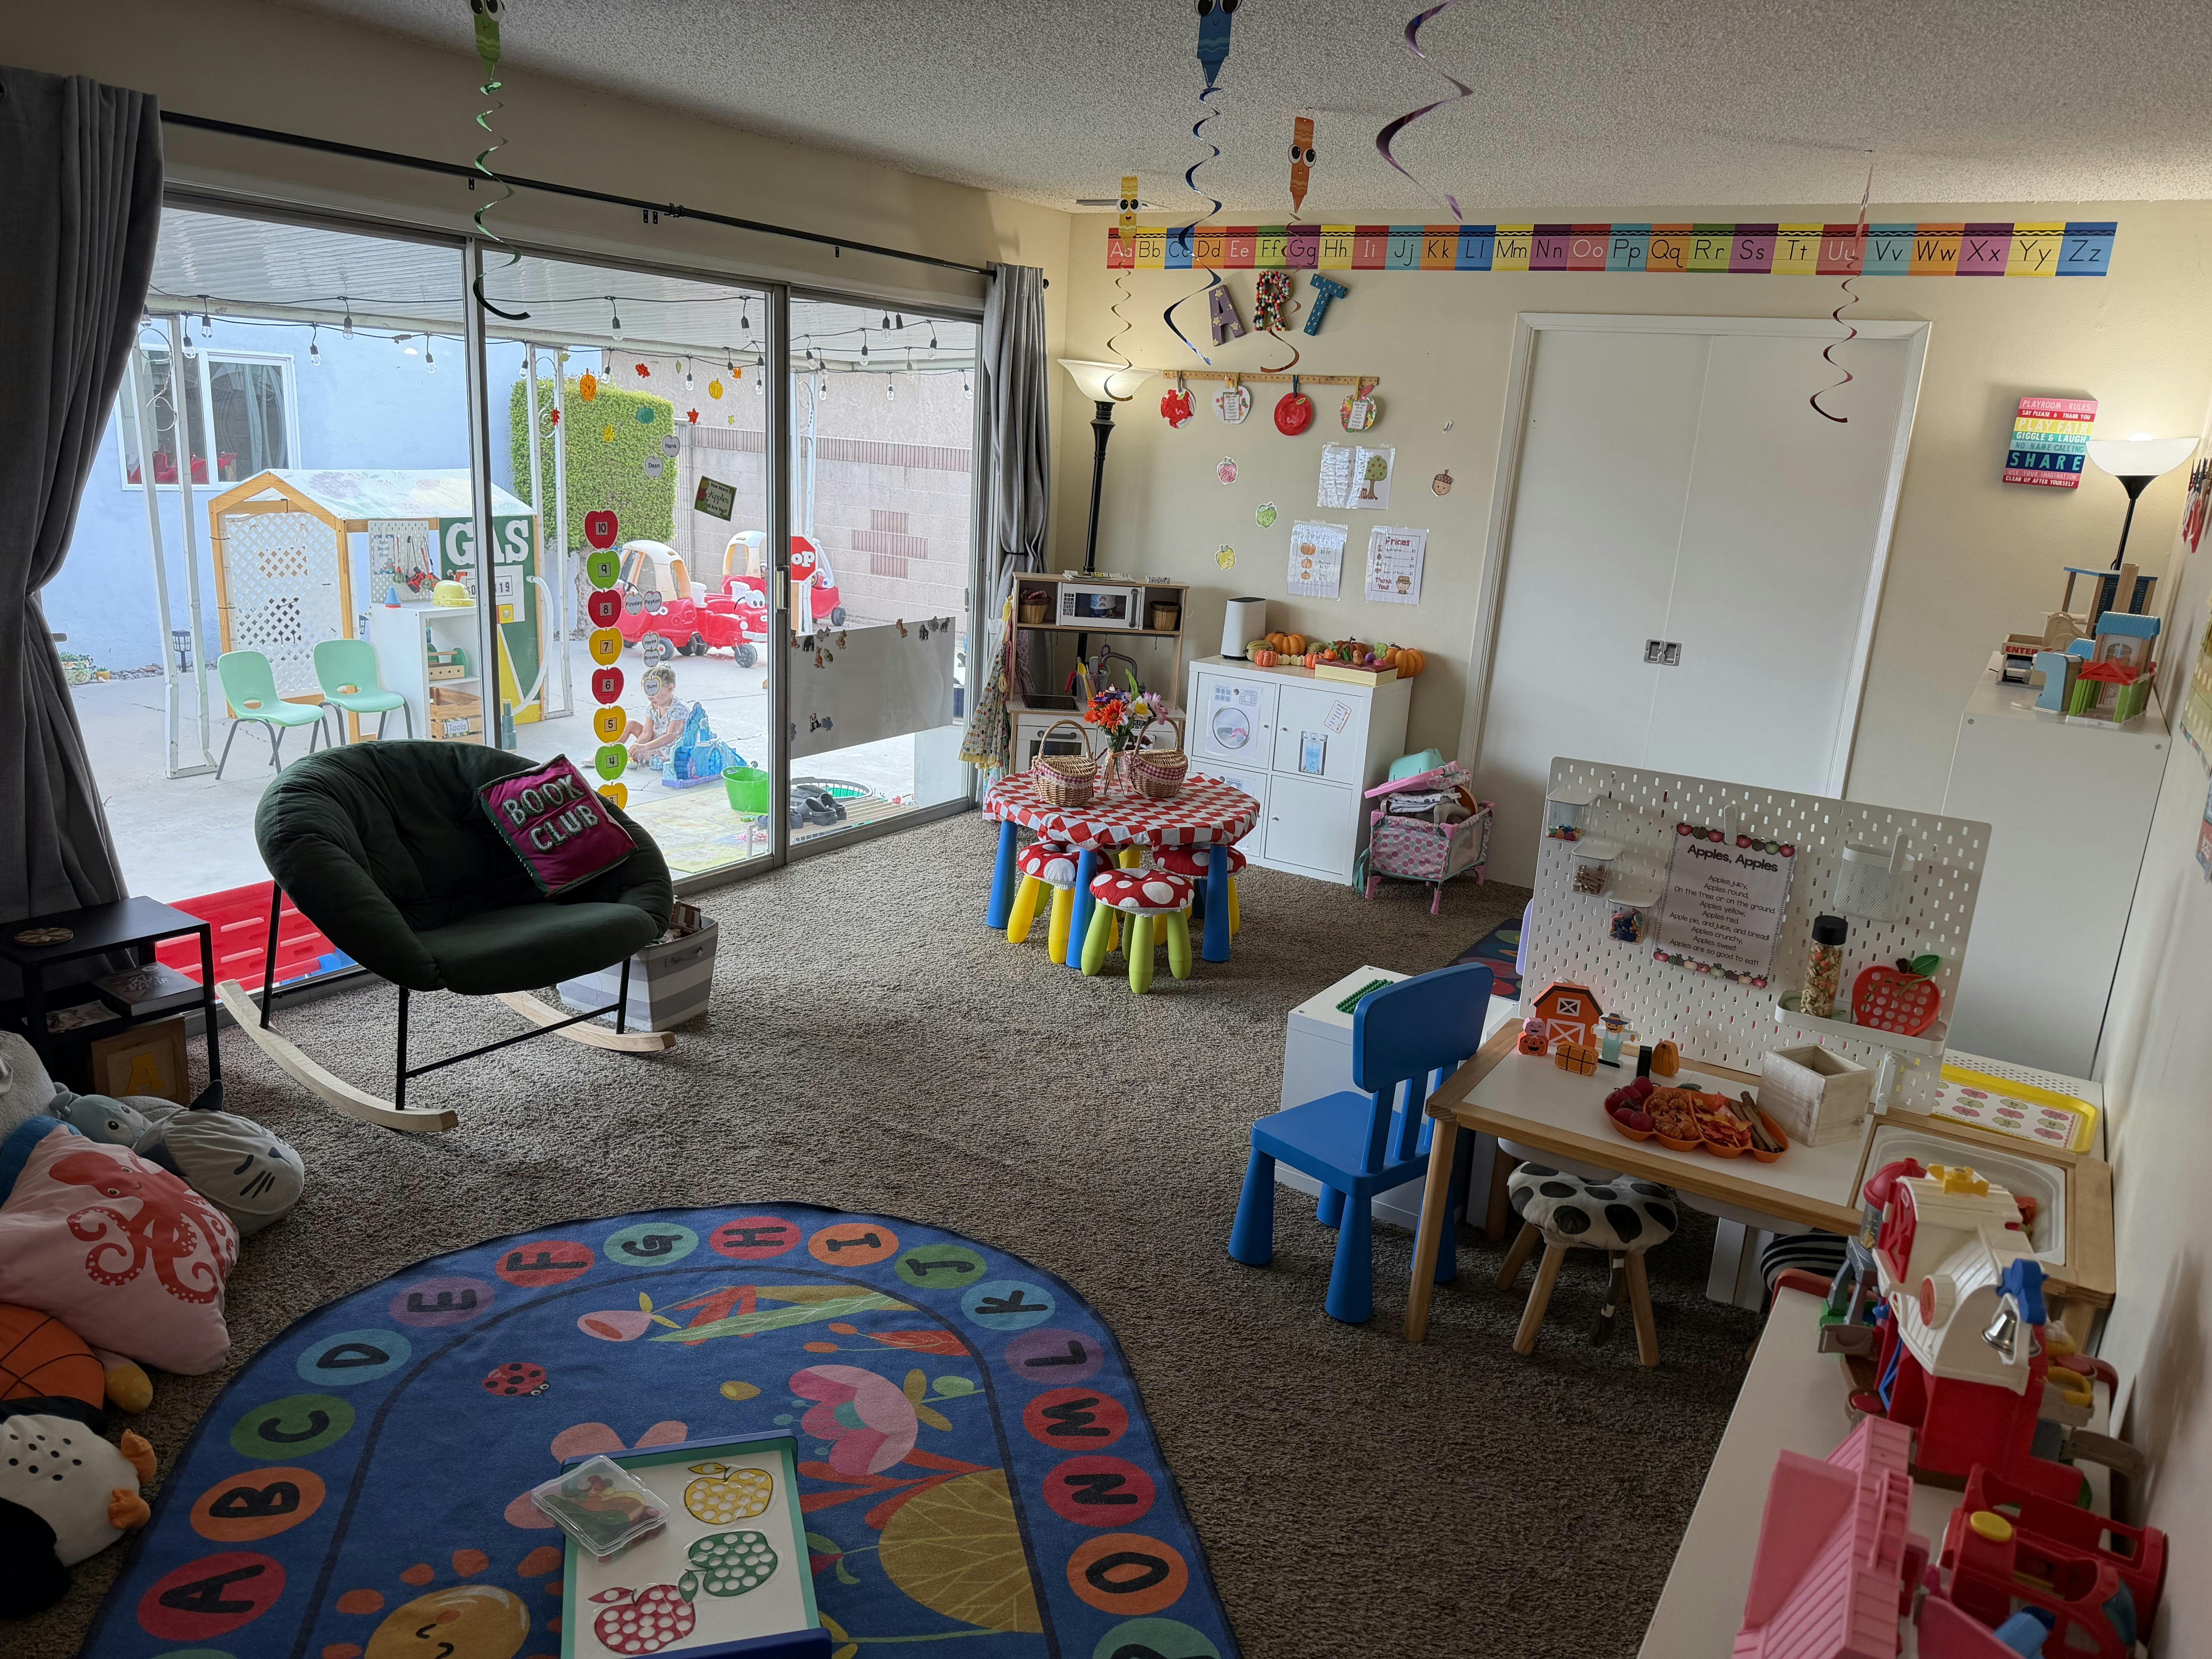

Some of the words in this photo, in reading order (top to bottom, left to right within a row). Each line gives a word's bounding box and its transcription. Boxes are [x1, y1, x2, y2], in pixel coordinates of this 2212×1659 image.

[1139, 241, 1160, 257] Bb
[1198, 240, 1220, 257] Dd
[1231, 240, 1249, 257] Ee
[1262, 240, 1280, 257] Ff
[1290, 239, 1316, 265] Gg
[1325, 240, 1346, 257] Hh
[1364, 240, 1375, 257] Ii
[1395, 240, 1413, 266] Jj
[1427, 240, 1449, 258] Kk
[1465, 240, 1484, 258] Ll
[1496, 240, 1527, 258] Mm
[1537, 239, 1562, 258] Nn
[1573, 239, 1603, 257] Oo
[1613, 239, 1640, 267] Pp
[1651, 239, 1683, 268] Qq
[1694, 239, 1724, 259] Rr
[1740, 240, 1764, 259] Ss
[1788, 240, 1807, 260] Tt
[1828, 240, 1857, 261] Uu
[1876, 240, 1903, 261] Vv
[1917, 240, 1956, 261] Ww
[1967, 240, 2001, 261] Xx
[2020, 240, 2051, 271] Yy
[2068, 240, 2100, 261] Zz
[2022, 400, 2061, 409] PLAYROOM
[2018, 418, 2052, 431] PLAY
[2057, 421, 2088, 434] FAIR
[2016, 432, 2045, 441] GIGGLE
[2058, 434, 2086, 443] LAUGH
[2010, 452, 2082, 471] SHARE
[2041, 472, 2076, 480] IMAGINATION
[708, 490, 729, 504] Apples
[599, 523, 606, 533] 10
[1385, 536, 1411, 546] Prices
[601, 564, 607, 574] 9
[603, 605, 609, 614] 8
[645, 599, 661, 607] Peyton
[604, 642, 609, 652] 7
[2006, 646, 2038, 655] ENTER
[606, 680, 611, 690] 6
[608, 720, 613, 728] 5
[609, 756, 615, 766] 4
[502, 774, 586, 829] BOOK
[529, 805, 599, 852] CLUB
[1687, 845, 1732, 864] Apples,
[1735, 854, 1778, 872] Apples
[1704, 884, 1726, 893] Apples
[1728, 889, 1749, 899] round,
[1708, 875, 1730, 884] Apples
[1730, 879, 1748, 890] juicy,
[1685, 887, 1697, 896] the
[1699, 890, 1714, 900] tree
[1736, 899, 1748, 907] the
[1700, 901, 1722, 911] Apples
[1724, 906, 1745, 917] yellow,
[1702, 910, 1724, 921] Apples
[1669, 912, 1688, 922] Apple
[1689, 917, 1700, 926] pie,
[1714, 922, 1731, 933] juice,
[1748, 930, 1769, 941] bread!
[1691, 926, 1713, 936] Apples
[1715, 933, 1743, 944] crunchy,
[1669, 939, 1692, 949] Apples
[1716, 951, 1733, 961] good
[1693, 936, 1715, 946] Apples
[621, 1234, 684, 1257] G
[723, 1225, 788, 1248] H
[826, 1232, 882, 1252] I
[506, 1251, 587, 1272] F
[905, 1257, 976, 1277] J
[407, 1289, 477, 1312] E
[975, 1290, 1048, 1315] K
[316, 1343, 390, 1369] D
[1024, 1340, 1089, 1367] L
[258, 1409, 330, 1443] C
[1042, 1396, 1110, 1437] M
[1063, 1473, 1139, 1505] N
[208, 1481, 301, 1519] B
[1085, 1551, 1170, 1594] O
[158, 1563, 266, 1614] A
